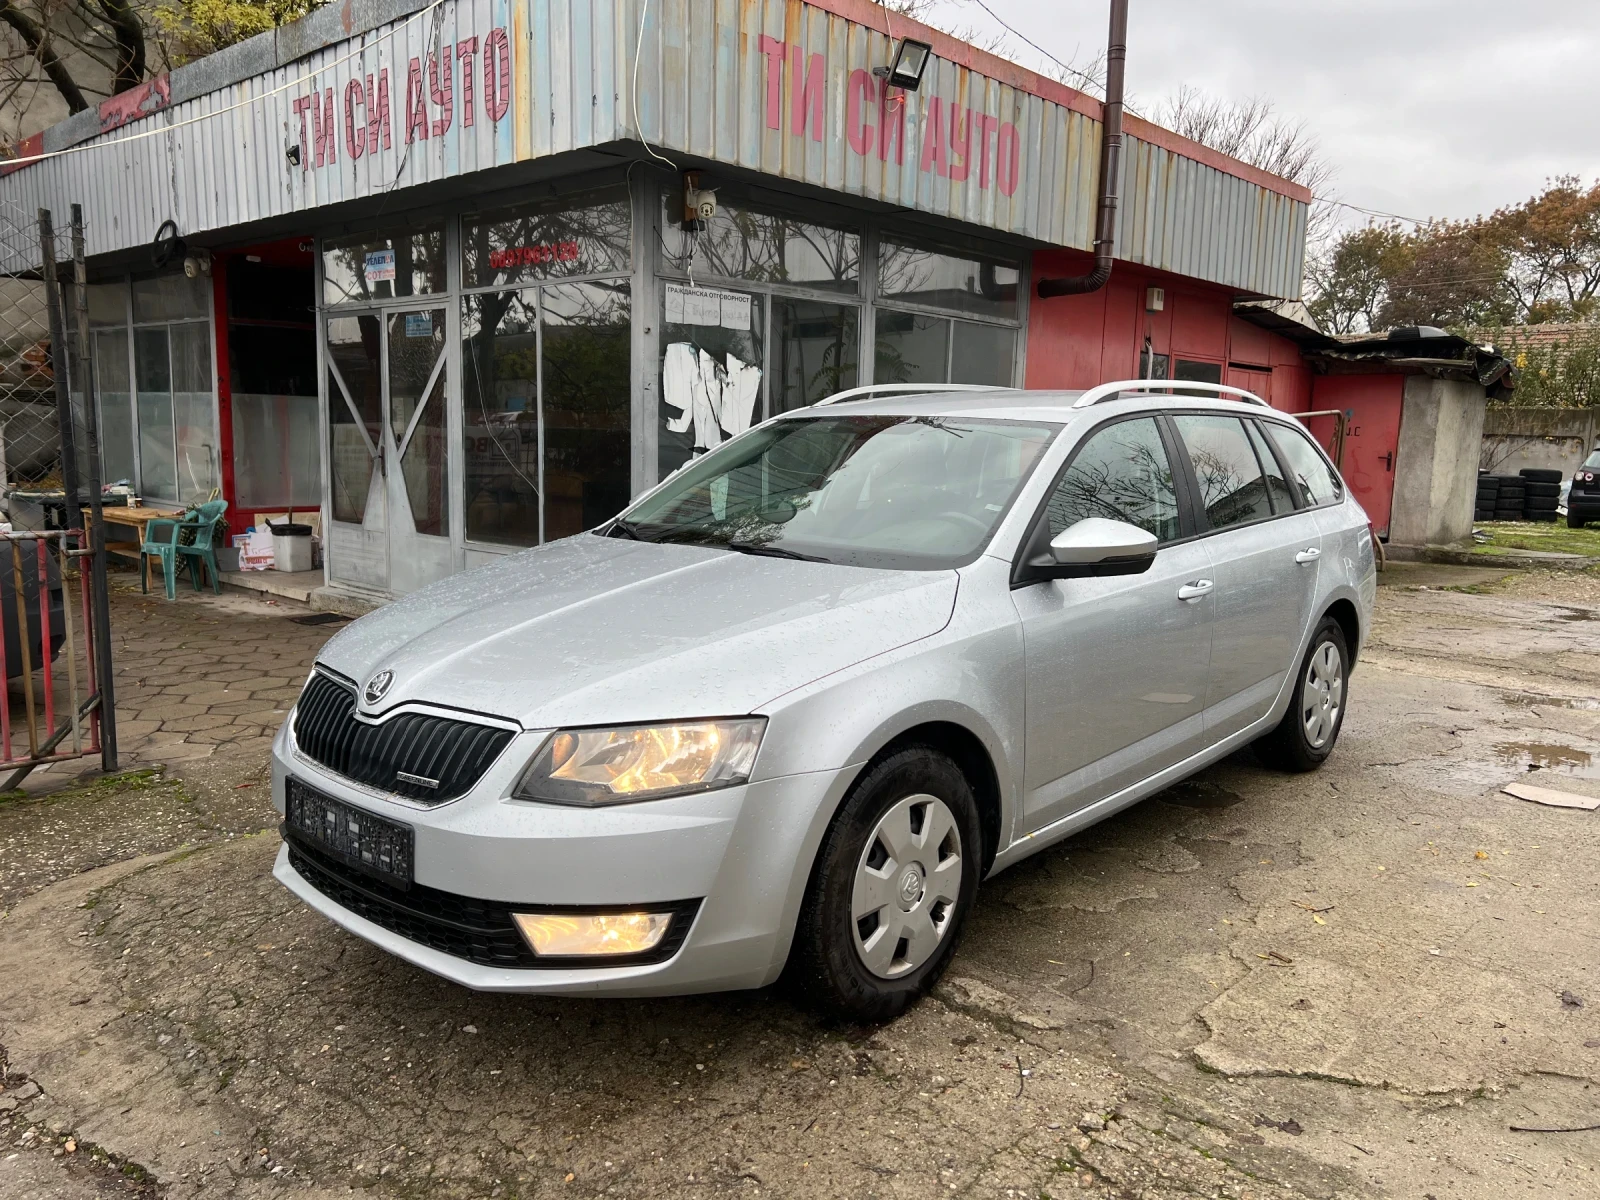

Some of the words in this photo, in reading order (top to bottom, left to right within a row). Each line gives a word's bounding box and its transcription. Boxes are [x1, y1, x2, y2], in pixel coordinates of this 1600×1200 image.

[293, 87, 336, 171] ТИ
[345, 68, 391, 160] СИ
[405, 28, 510, 144] АУТО
[758, 34, 824, 142] ТИ
[848, 68, 905, 166] СИ
[920, 95, 1020, 197] АУТО
[667, 286, 708, 298] ГРАЖДАНСКА
